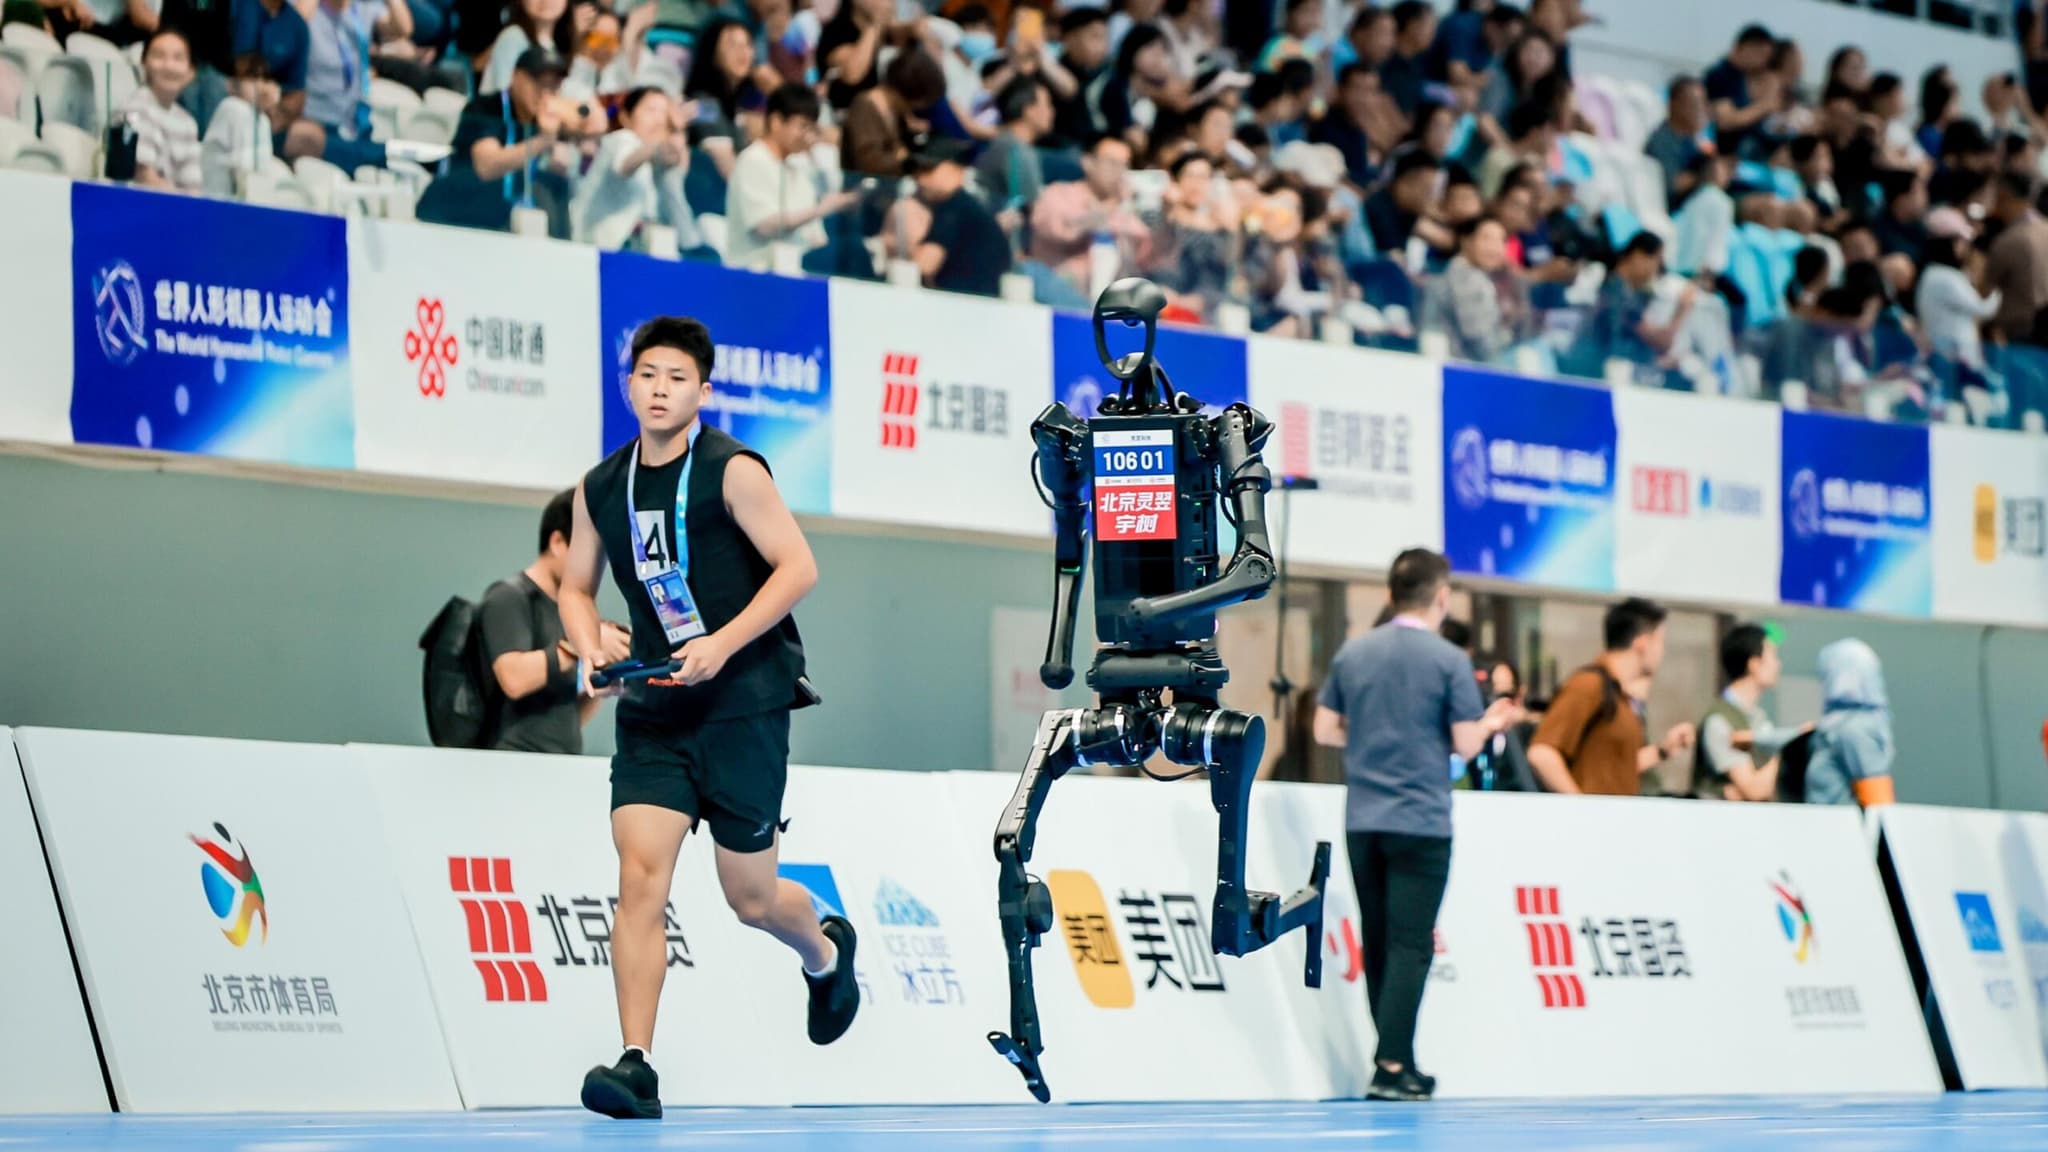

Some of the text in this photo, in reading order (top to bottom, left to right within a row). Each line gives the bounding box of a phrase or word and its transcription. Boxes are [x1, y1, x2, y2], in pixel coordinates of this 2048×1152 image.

[465, 313, 544, 366] 中国联通
[1103, 450, 1164, 471] 10601
[1099, 491, 1172, 512] 北京灵翌
[1115, 513, 1159, 534] 宇树
[645, 522, 667, 570] 4
[536, 894, 694, 967] 北京资
[1065, 914, 1119, 965] 美团
[1119, 889, 1226, 991] 美团
[1580, 917, 1693, 976] 北京国资
[201, 973, 338, 1016] 北京市体育局
